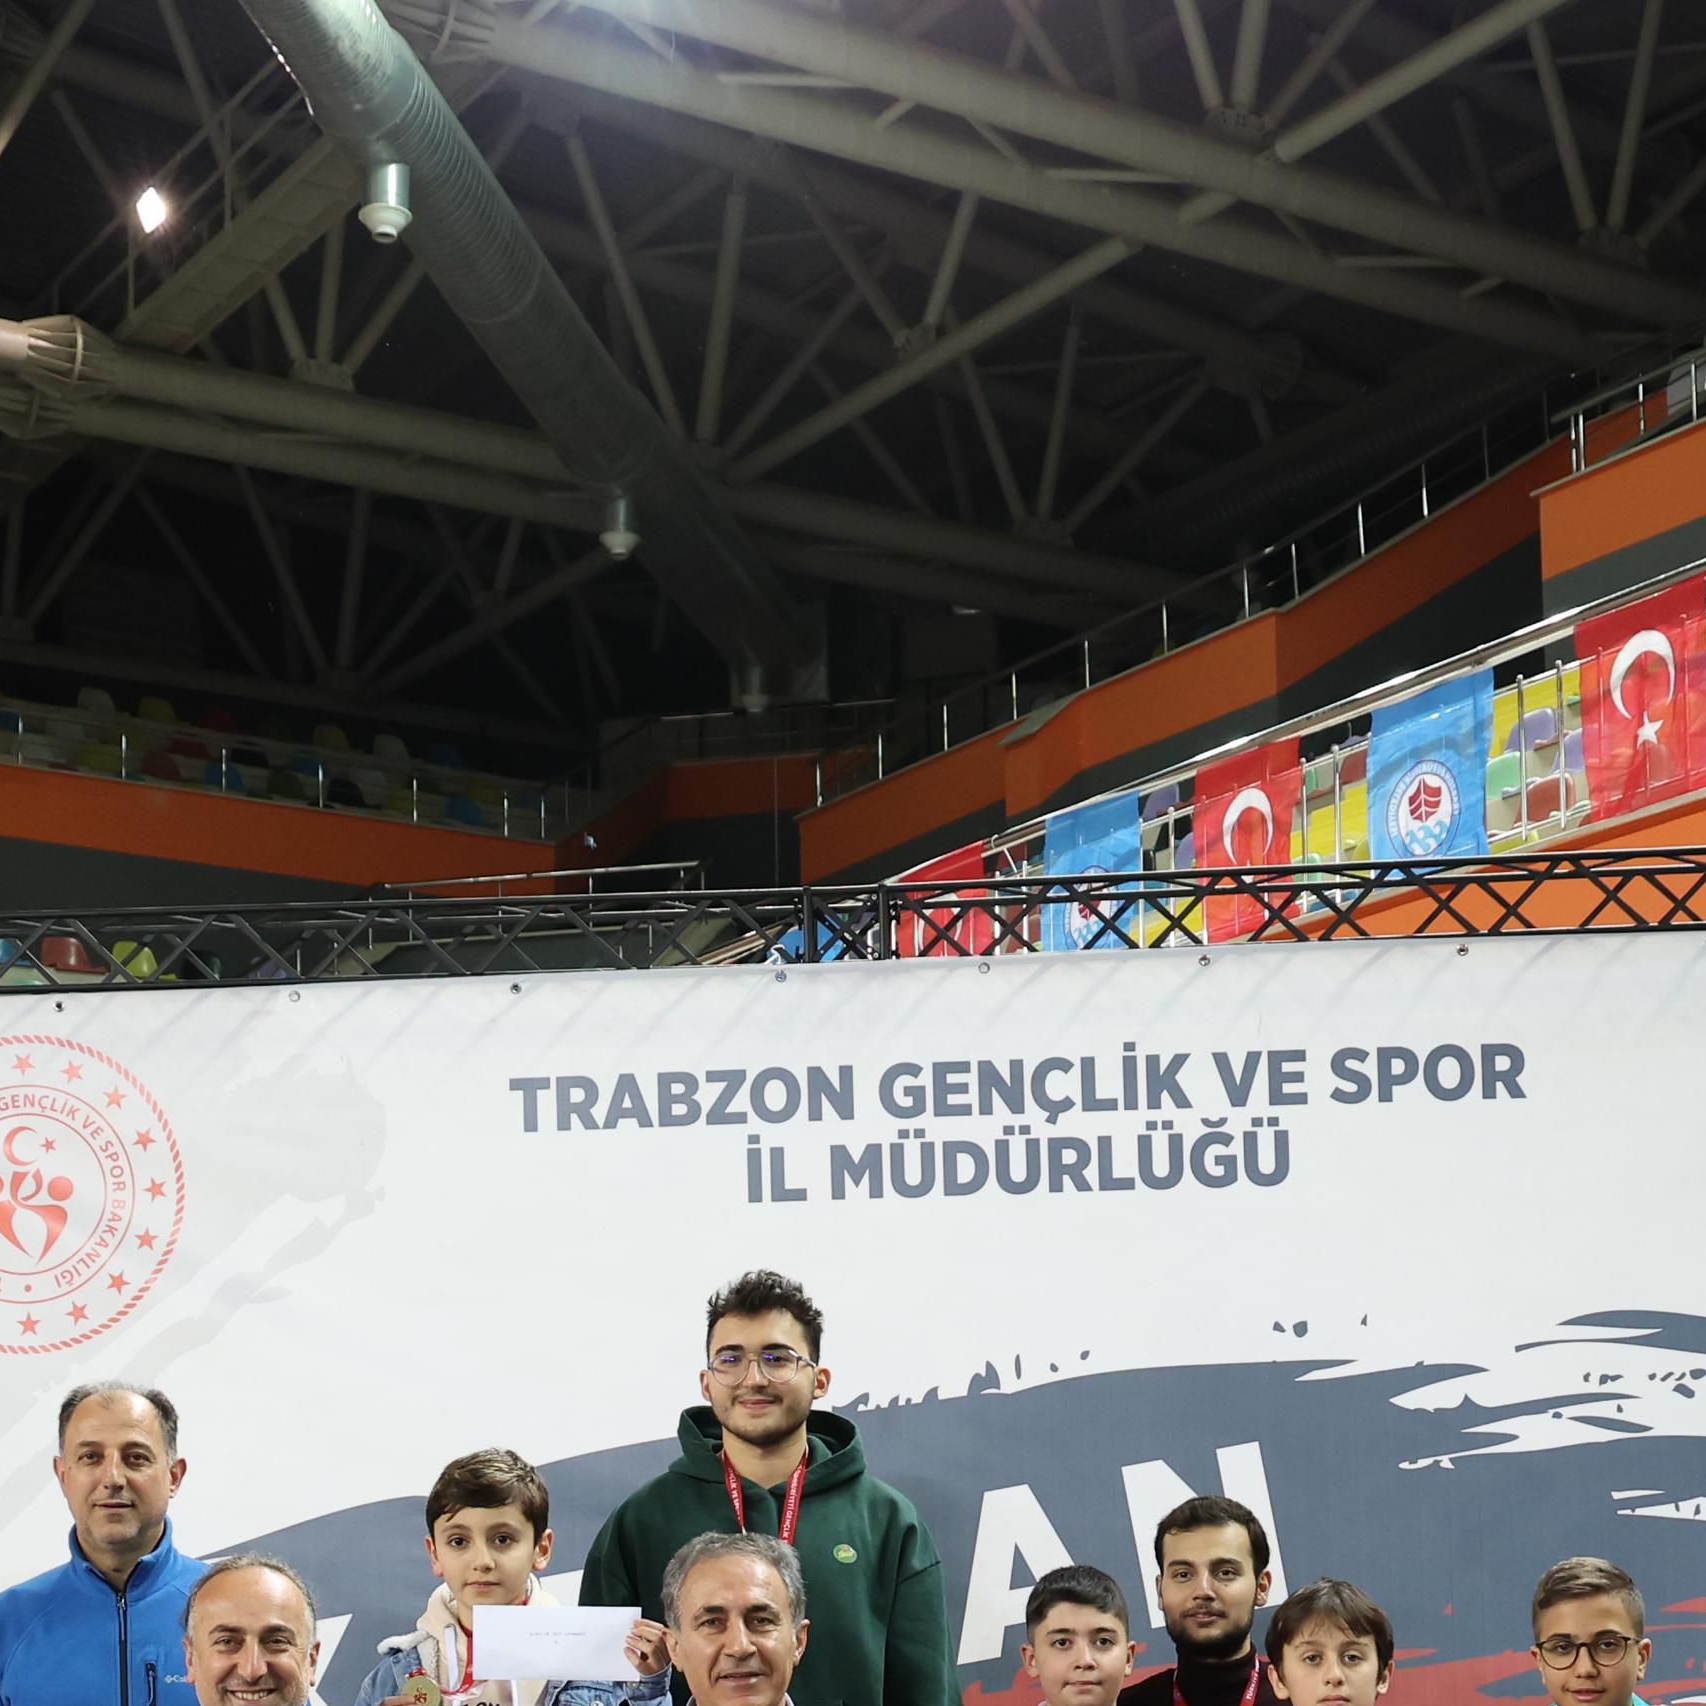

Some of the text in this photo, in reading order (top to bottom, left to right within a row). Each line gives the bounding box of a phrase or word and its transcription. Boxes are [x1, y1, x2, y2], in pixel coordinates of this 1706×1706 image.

[81, 1115, 105, 1140] VE
[510, 1041, 1528, 1132] TRABZON GENÇLİK VE SPOR
[99, 1140, 126, 1192] SPOR
[747, 1117, 1291, 1203] İL MÜDÜRLÜĞÜ
[54, 1199, 127, 1289] BAKANLIĞI
